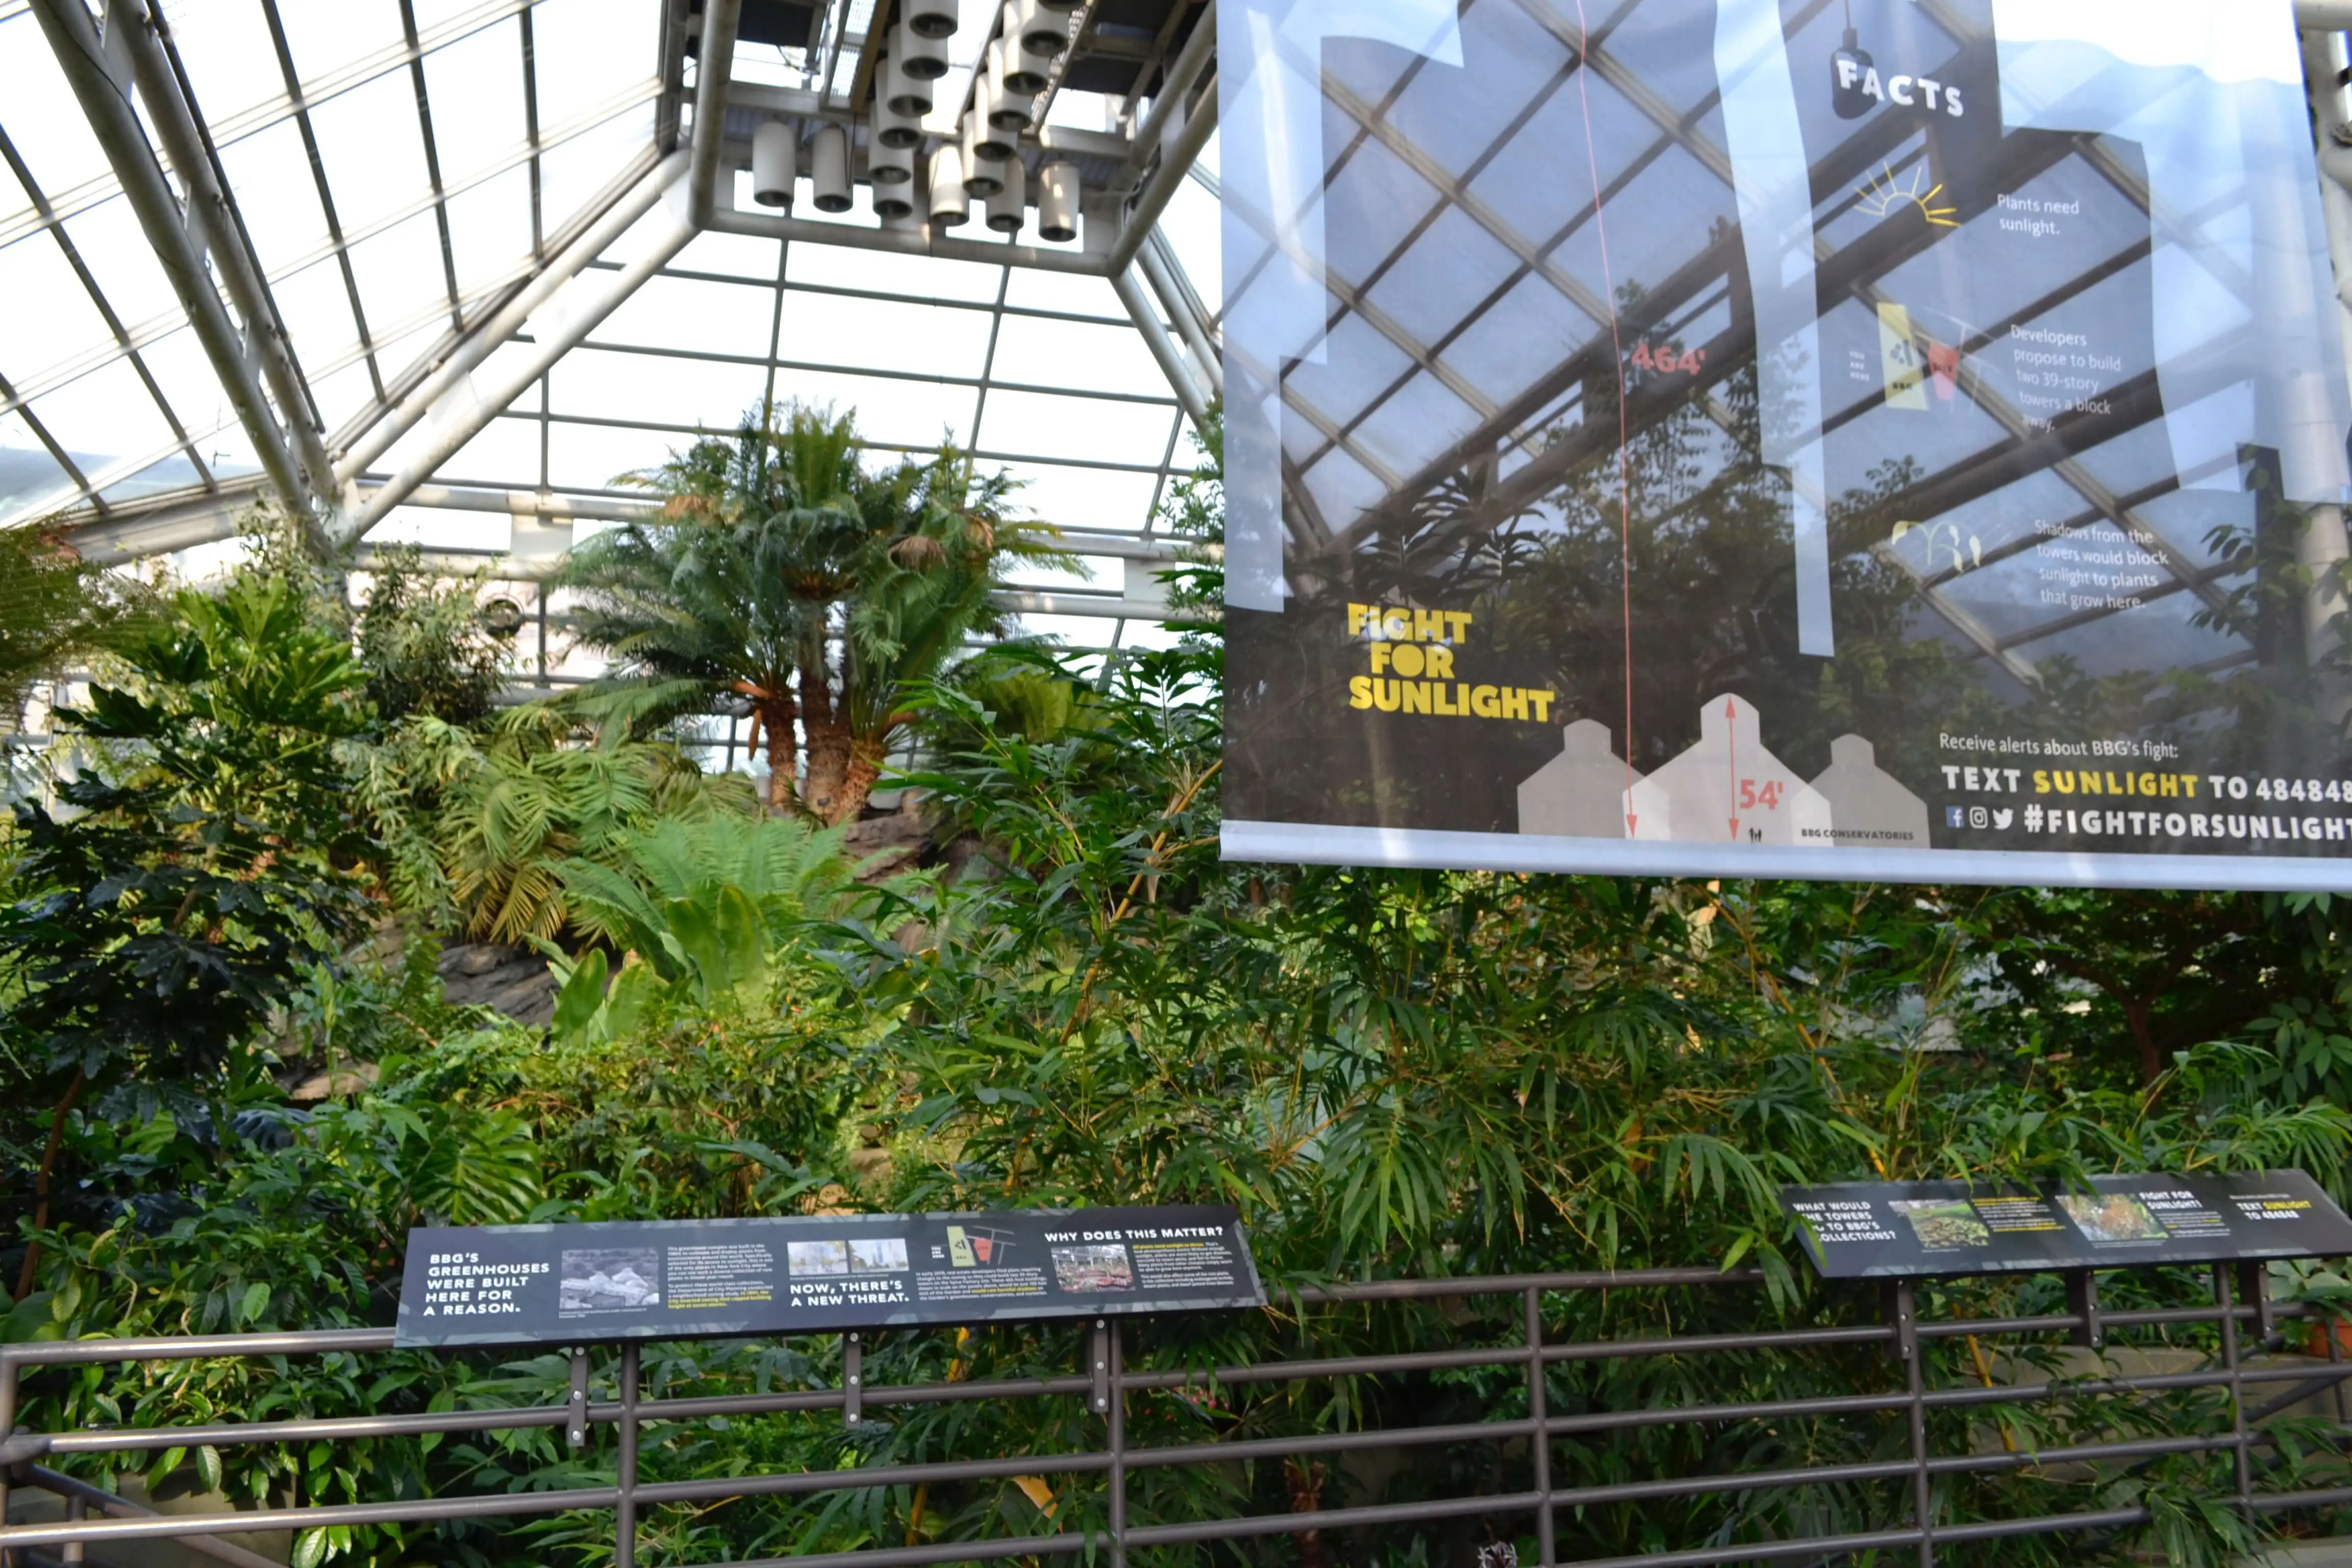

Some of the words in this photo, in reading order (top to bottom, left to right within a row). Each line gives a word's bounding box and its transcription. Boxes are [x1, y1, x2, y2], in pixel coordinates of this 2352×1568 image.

[1836, 59, 1964, 118] FACTS
[1997, 193, 2041, 214] Plants
[2044, 199, 2079, 215] need
[1999, 216, 2061, 237] sunlight.
[2011, 324, 2088, 348] Developers
[1631, 344, 1706, 375] 464'
[2014, 349, 2068, 369] propose
[2071, 352, 2086, 367] to
[2089, 353, 2121, 371] build
[2017, 371, 2039, 386] two
[2042, 372, 2098, 394] 39-story
[2019, 390, 2062, 410] towers
[2065, 399, 2073, 410] a
[2076, 397, 2111, 415] block
[2022, 416, 2055, 432] away.
[2034, 519, 2089, 542] Shadows
[2091, 526, 2124, 544] from
[2127, 528, 2154, 544] the
[2037, 545, 2080, 562] towers
[2081, 548, 2124, 565] would
[2127, 549, 2169, 566] block
[2039, 566, 2091, 587] sunlight
[2093, 572, 2108, 586] to
[2111, 571, 2159, 589] plants
[2041, 588, 2067, 604] that
[2070, 594, 2104, 610] grow
[2106, 594, 2146, 609] here.
[1348, 602, 1473, 645] FIGHT
[1370, 642, 1456, 680] FOR
[1349, 675, 1555, 723] SUNLIGHT
[1940, 732, 1996, 752] Receive
[1999, 736, 2040, 754] alerts
[2043, 738, 2088, 756] about
[2092, 740, 2139, 756] BBG's
[2142, 740, 2179, 760] fight:
[1941, 765, 2022, 793] TEXT
[2033, 770, 2198, 798] SUNLIGHT
[2208, 775, 2248, 800] TO
[2256, 777, 2352, 803] 484848
[1739, 779, 1783, 811] 54'
[1801, 828, 1821, 838] BBG
[1823, 829, 1915, 840] CONSERVATORIES
[2139, 1192, 2171, 1200] FIGHT
[2171, 1190, 2194, 1199] FOR
[2263, 1200, 2312, 1210] SUNLIGHT
[1792, 1203, 1826, 1211] WHAT
[1828, 1201, 1871, 1210] WOULD
[1824, 1211, 1872, 1220] TOWERS
[2244, 1211, 2261, 1220] TO
[1045, 1232, 1079, 1243] WHY
[1083, 1230, 1123, 1241] DOES
[1126, 1229, 1157, 1240] THIS
[1161, 1226, 1224, 1239] MATTER?
[1826, 1222, 1843, 1231] TO
[1846, 1221, 1880, 1231] BBG'S
[428, 1262, 550, 1276] GREENHOUSES
[430, 1253, 479, 1264] BBG'S
[427, 1278, 475, 1290] WERE
[484, 1276, 529, 1288] BUILT
[790, 1284, 836, 1294] NOW,
[839, 1280, 902, 1291] THERE'S
[425, 1291, 470, 1303] HERE
[478, 1290, 512, 1301] FOR
[791, 1297, 802, 1307] A
[808, 1295, 842, 1306] NEW
[848, 1292, 910, 1304] THREAT.
[423, 1304, 436, 1316] A
[444, 1302, 521, 1316] REASON.
